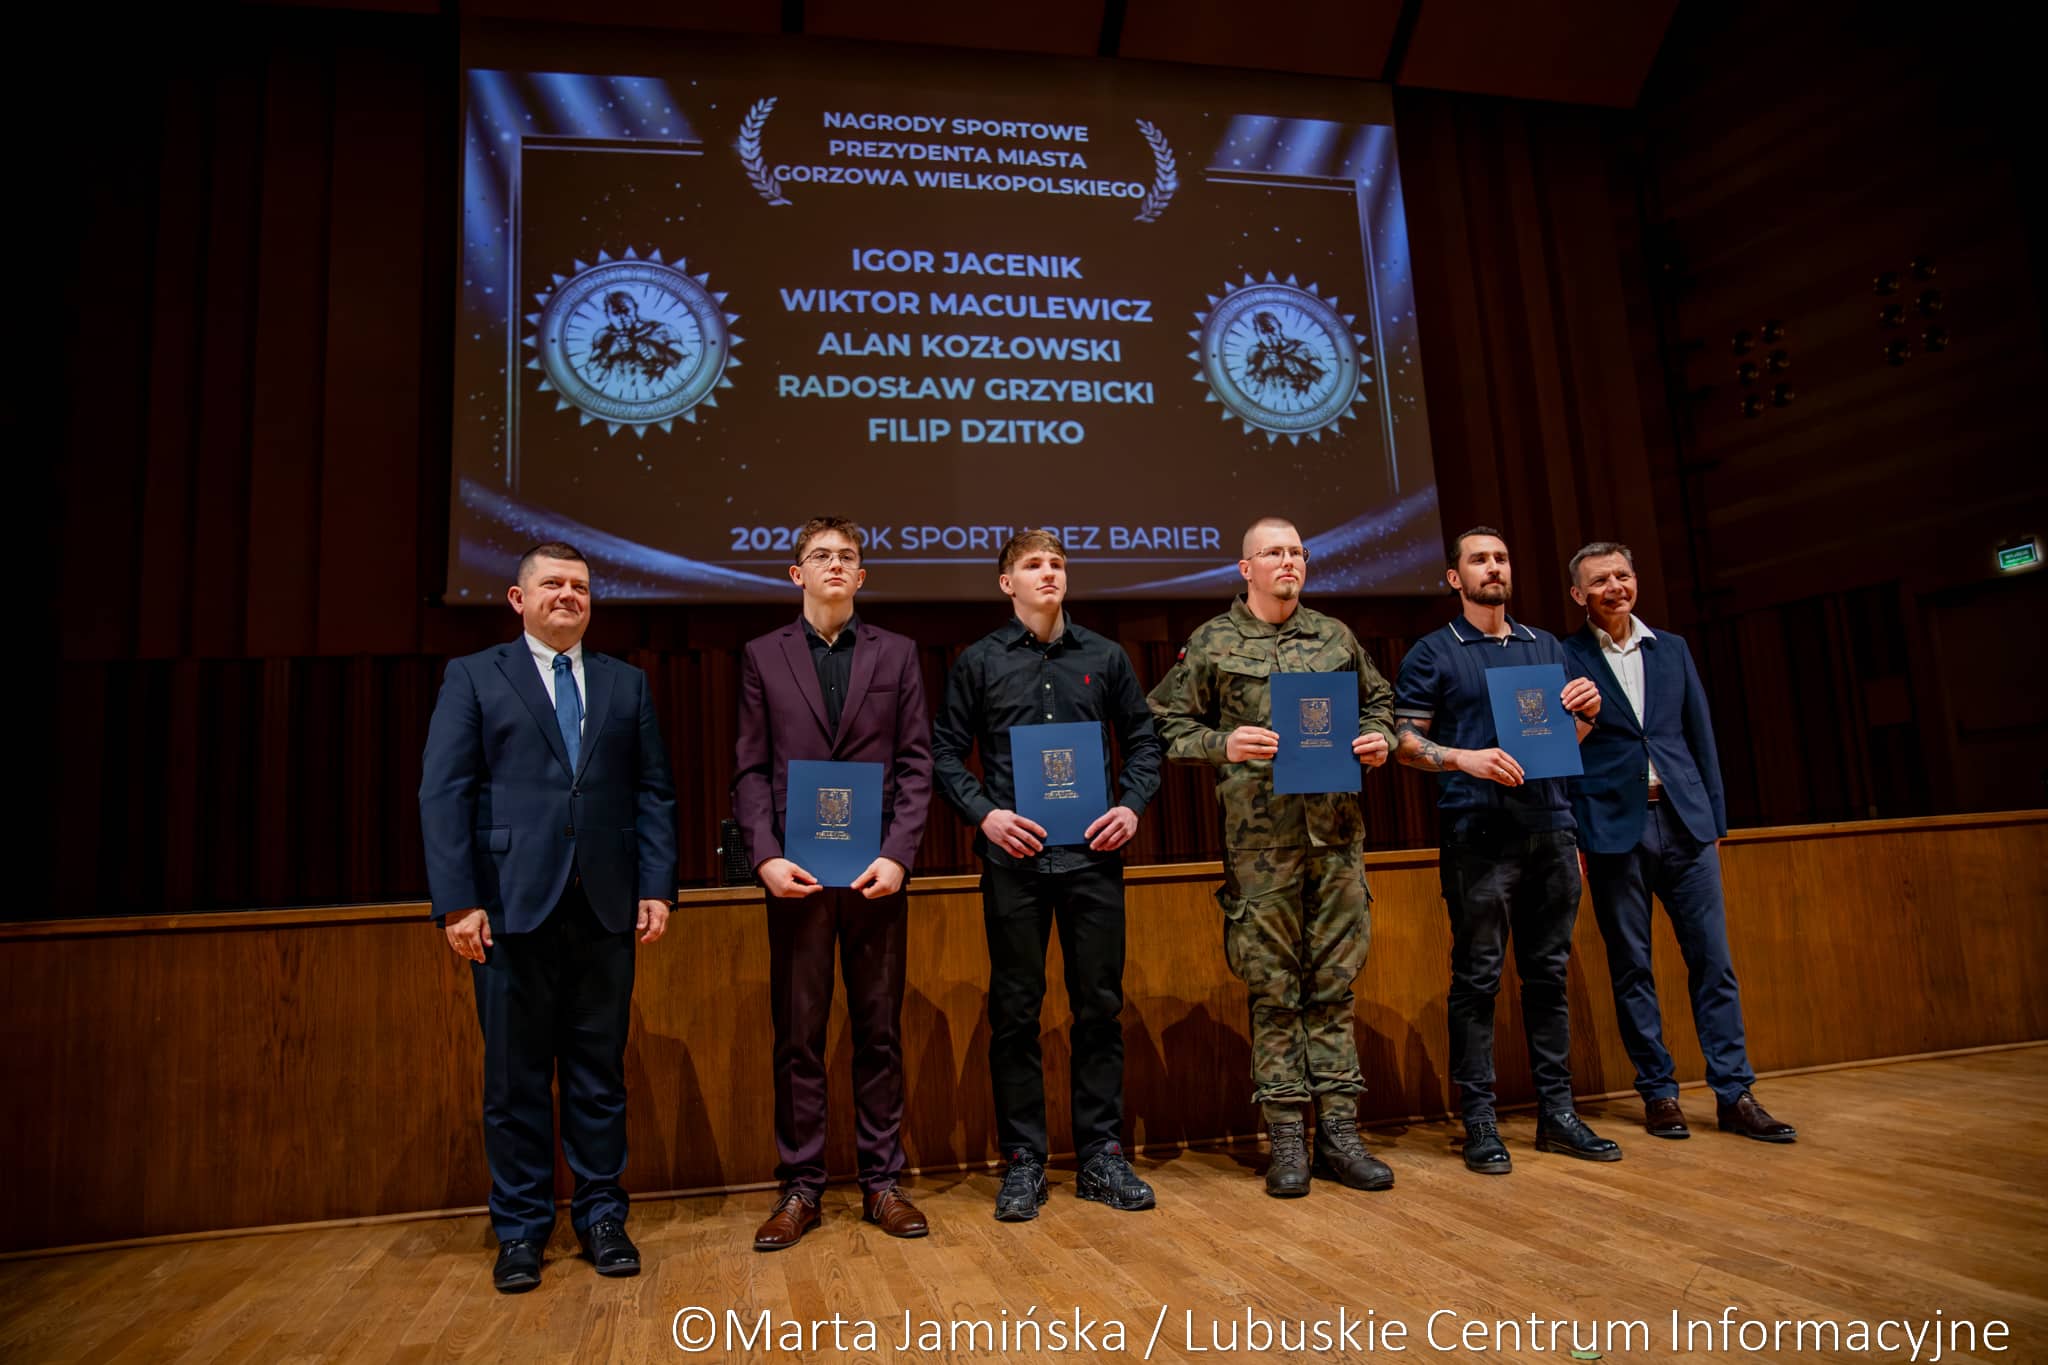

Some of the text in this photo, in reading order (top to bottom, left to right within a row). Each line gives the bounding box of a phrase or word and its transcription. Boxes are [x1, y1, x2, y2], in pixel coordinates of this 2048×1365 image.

[824, 111, 1089, 142] NAGRODY SPORTOWE
[830, 139, 1086, 168] PREZYDENTA MIASTA
[774, 164, 1146, 198] GORZOWA WIELKOPOLSKIEGO
[852, 247, 1083, 279] IGOR JACENIK
[780, 287, 1153, 322] WIKTOR MACULEWICZ
[818, 331, 1121, 362] ALAN KOZŁOWSKI
[779, 374, 1154, 404] RADOSŁAW GRZYBICKI
[869, 418, 1085, 444] FILIP DZITKO
[1109, 526, 1220, 550] BARIER
